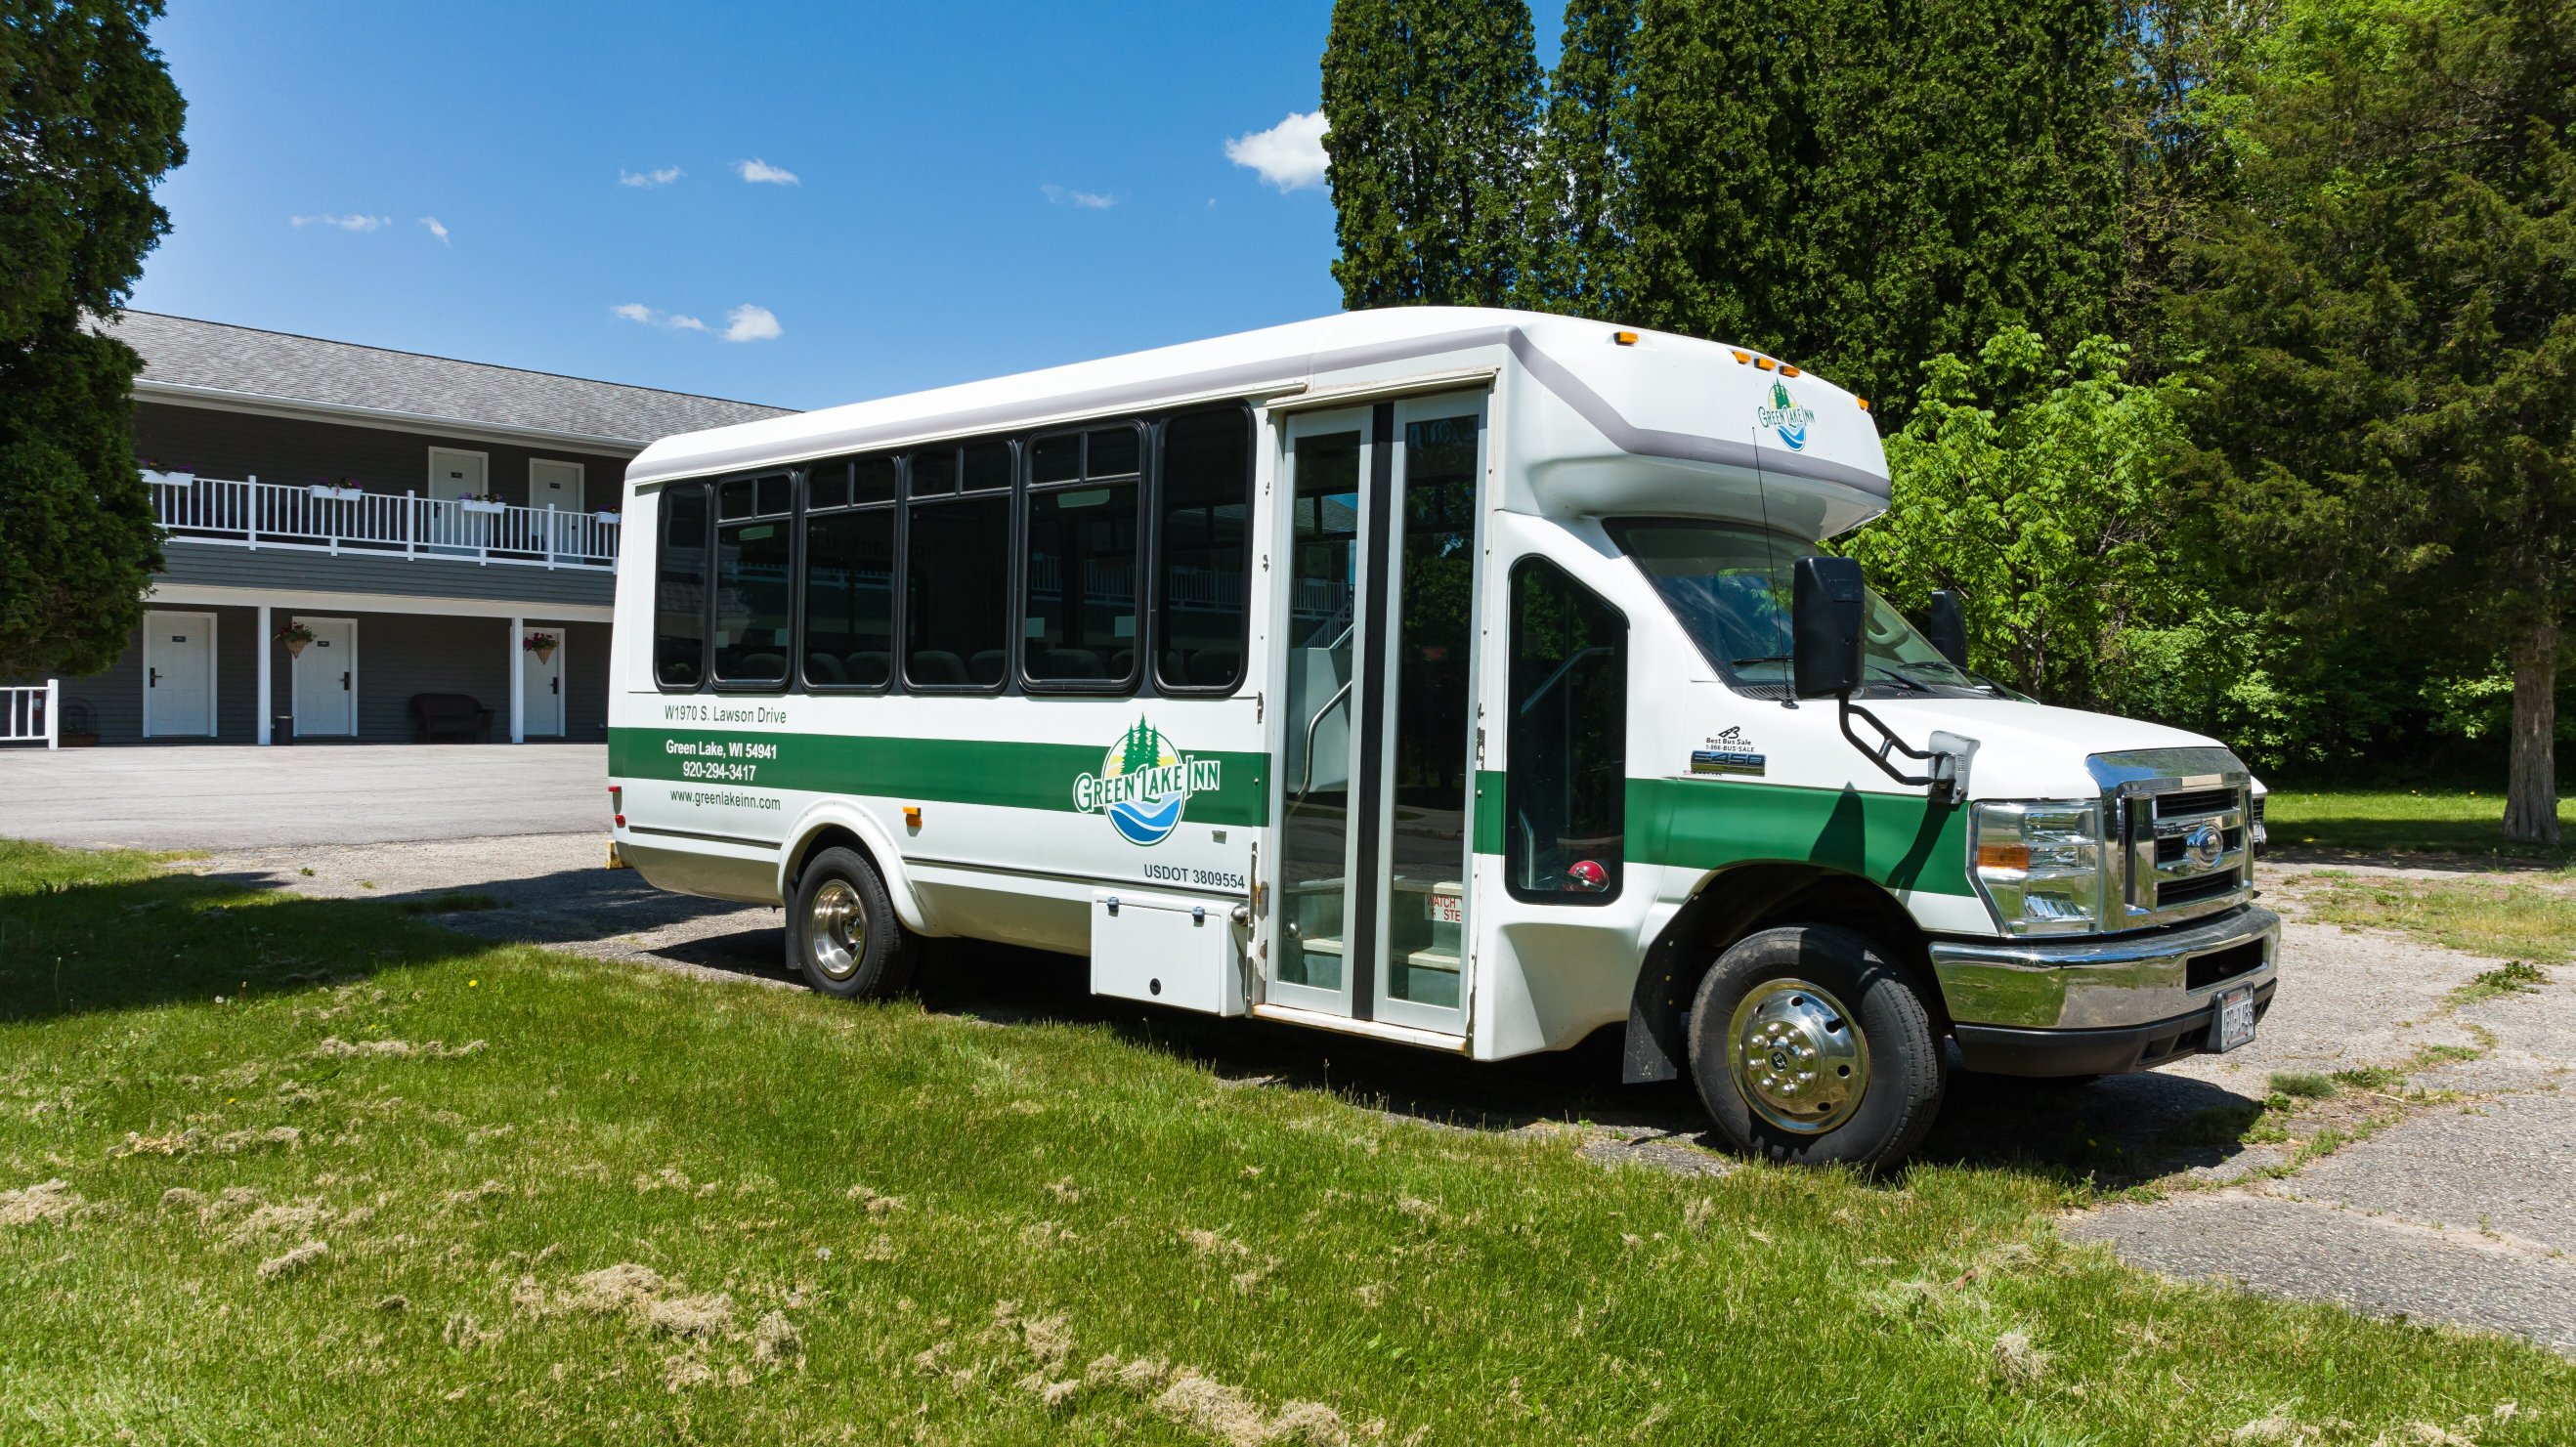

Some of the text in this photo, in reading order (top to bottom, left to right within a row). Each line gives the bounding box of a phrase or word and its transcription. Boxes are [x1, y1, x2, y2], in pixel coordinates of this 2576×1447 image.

[1758, 404, 1815, 428] GREEN LAKE INN
[665, 704, 787, 724] W1970 S. Lawson Drive
[665, 740, 777, 759] Green Lake, WI 54941
[682, 761, 756, 782] 920-294-3417
[1075, 755, 1221, 812] GREEN LAKE INN
[670, 790, 781, 810] www.greenlakeinn.com
[1143, 864, 1246, 889] USDOT 3809554
[1427, 894, 1456, 909] WATCH
[1443, 909, 1461, 922] STE
